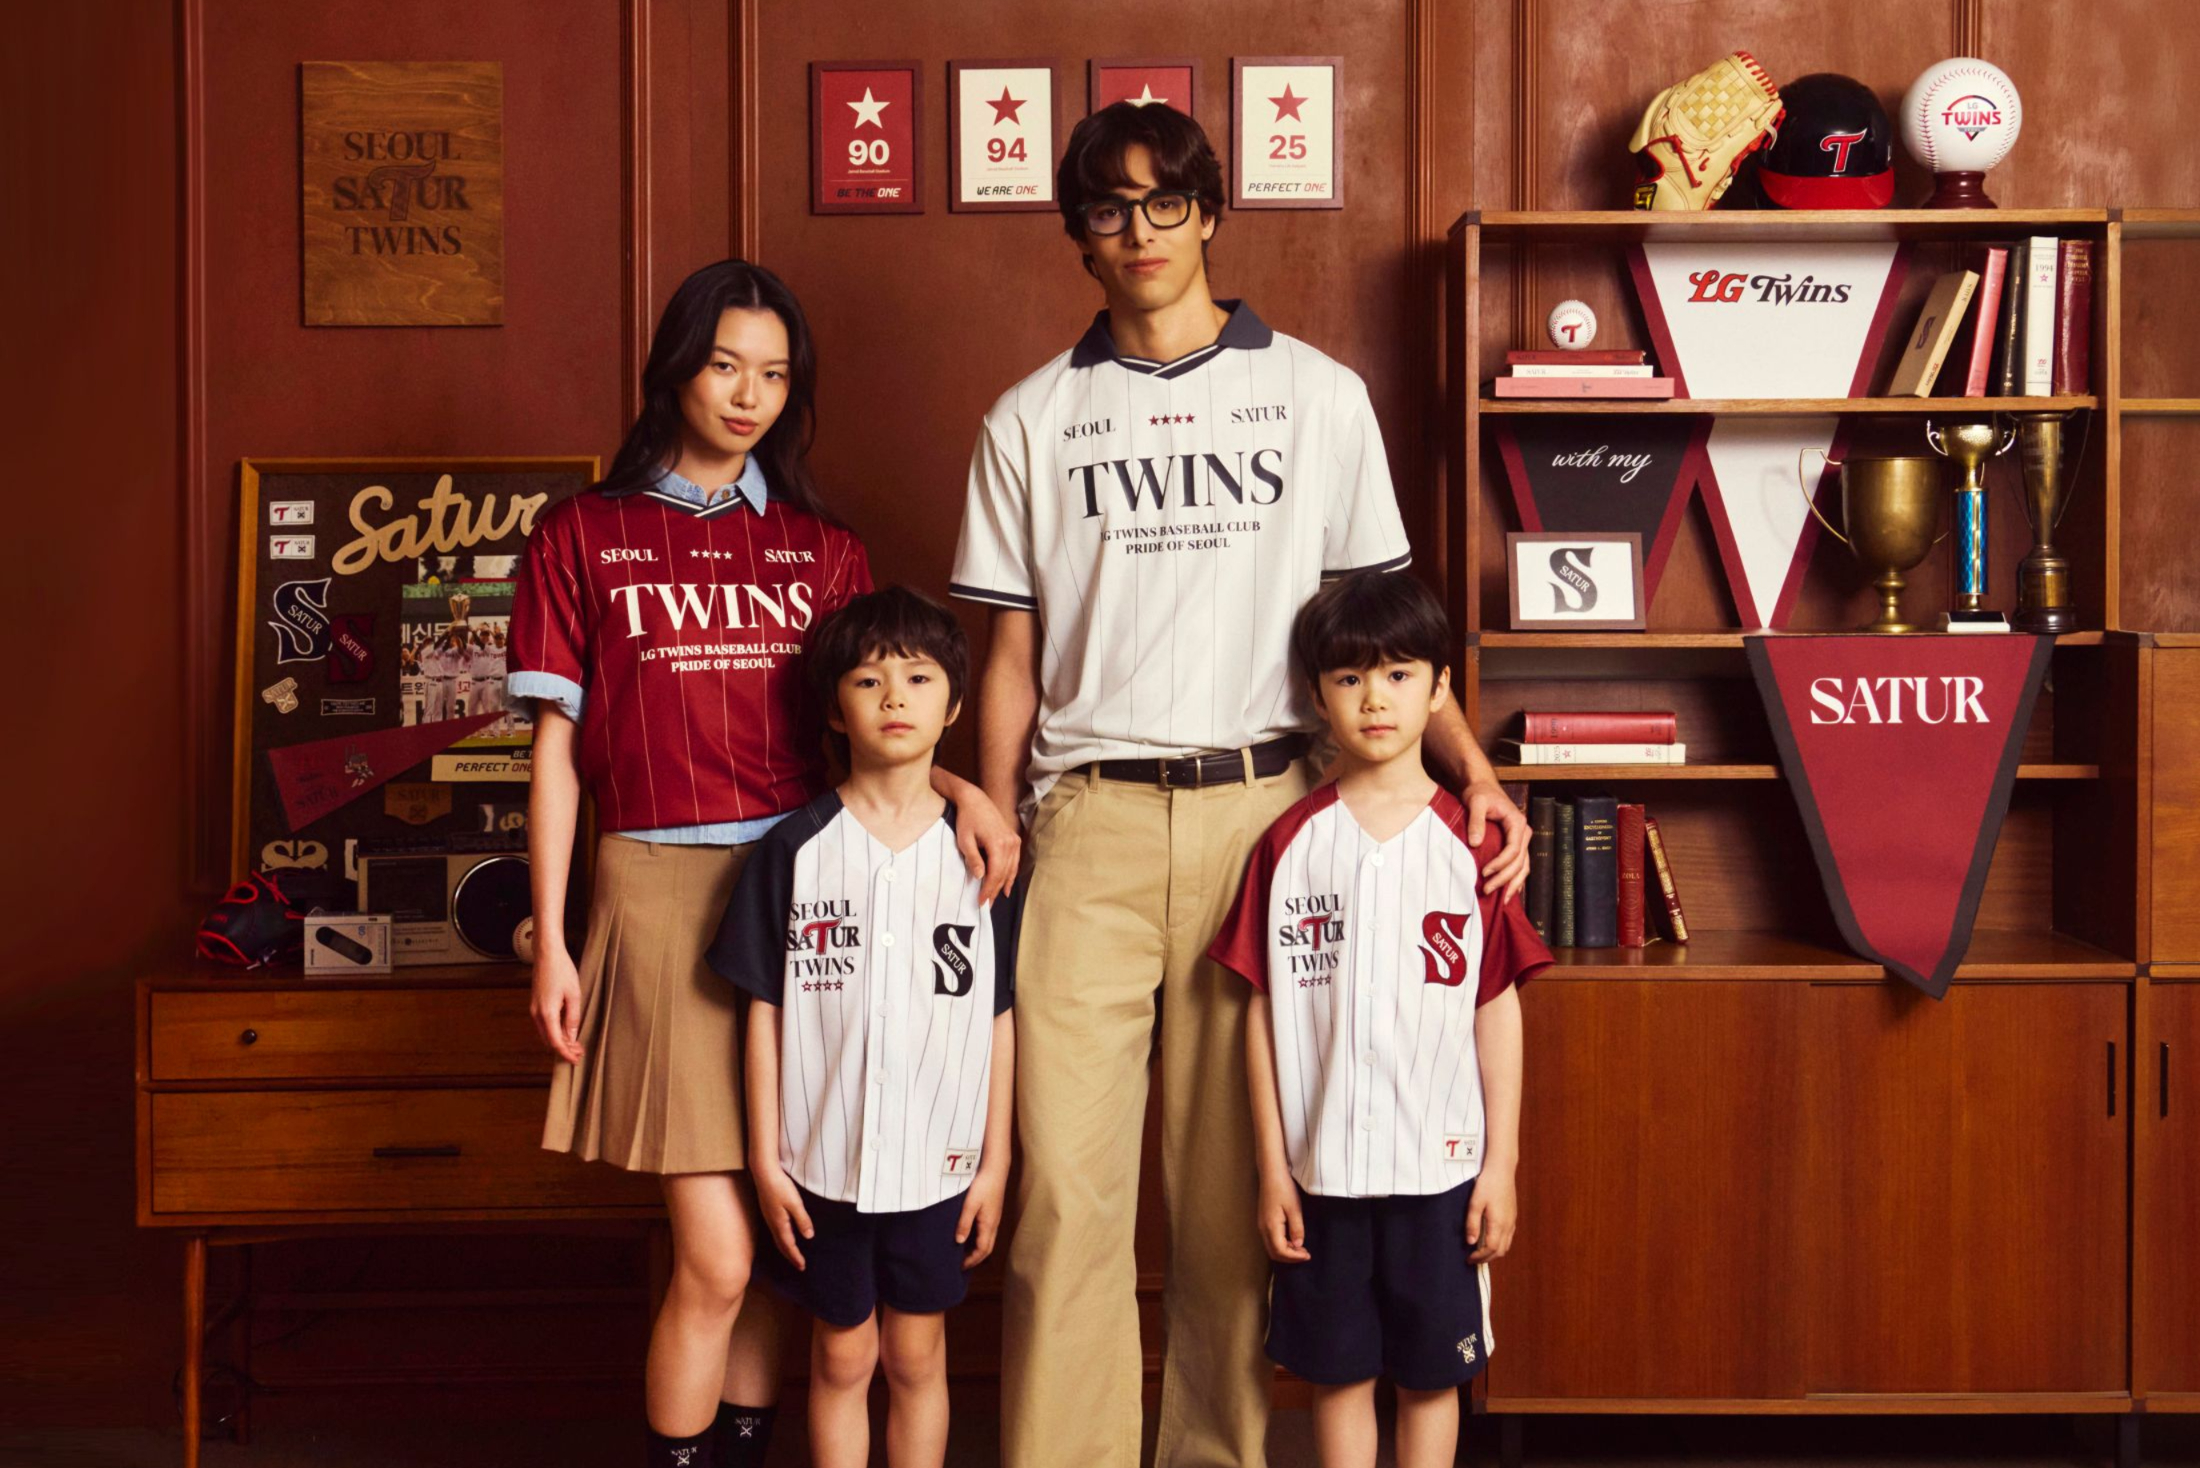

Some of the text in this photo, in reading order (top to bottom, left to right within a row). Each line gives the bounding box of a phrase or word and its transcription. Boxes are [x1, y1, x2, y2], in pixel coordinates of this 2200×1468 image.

[1941, 111, 2001, 125] TWINS
[344, 131, 461, 161] SEOUL
[848, 139, 890, 166] 90
[987, 137, 1027, 163] 94
[1269, 134, 1307, 160] 25
[1820, 128, 1867, 173] T
[333, 159, 472, 221] SATUR
[837, 187, 902, 198] BE THE ONE
[977, 185, 1038, 195] WE ARE ONE
[1248, 183, 1327, 192] PERFECT ONE
[345, 226, 461, 255] TWINS
[2034, 264, 2053, 273] 1994
[1687, 269, 1852, 306] LG Twins
[1561, 322, 1583, 343] T
[1063, 405, 1287, 442] SEOUL SATUR
[1551, 445, 1653, 484] with my
[1068, 449, 1284, 519] TWINS
[274, 506, 290, 521] T
[332, 474, 548, 575] Satur
[1113, 527, 1157, 540] TWINS
[1160, 522, 1224, 536] BASEBALL
[1227, 521, 1261, 532] CLUB
[274, 540, 291, 554] T
[600, 548, 815, 564] SEOUL SATUR
[1126, 538, 1231, 554] PRIDE OF SEOUL
[1560, 565, 1590, 593] SATUR
[288, 604, 323, 635] SATUR
[610, 582, 813, 638] TWINS
[340, 634, 367, 661] SATUR
[641, 643, 801, 661] LG TWINS BASEBALL CLUB
[671, 658, 775, 673] PRIDE OF SEOUL
[1810, 676, 1990, 724] SATUR
[513, 750, 526, 759] BE
[455, 763, 510, 772] PERFECT
[1622, 872, 1641, 880] ZOLA
[789, 900, 857, 921] SEOUL
[1285, 894, 1345, 915] SEOUL
[786, 917, 861, 955] SATUR
[1279, 913, 1345, 951] SATUR
[941, 943, 966, 974] SATUR
[1432, 932, 1458, 964] SATUR
[790, 956, 855, 978] TWINS
[1288, 950, 1339, 973] TWINS
[1446, 1139, 1461, 1157] T
[947, 1154, 963, 1171] T
